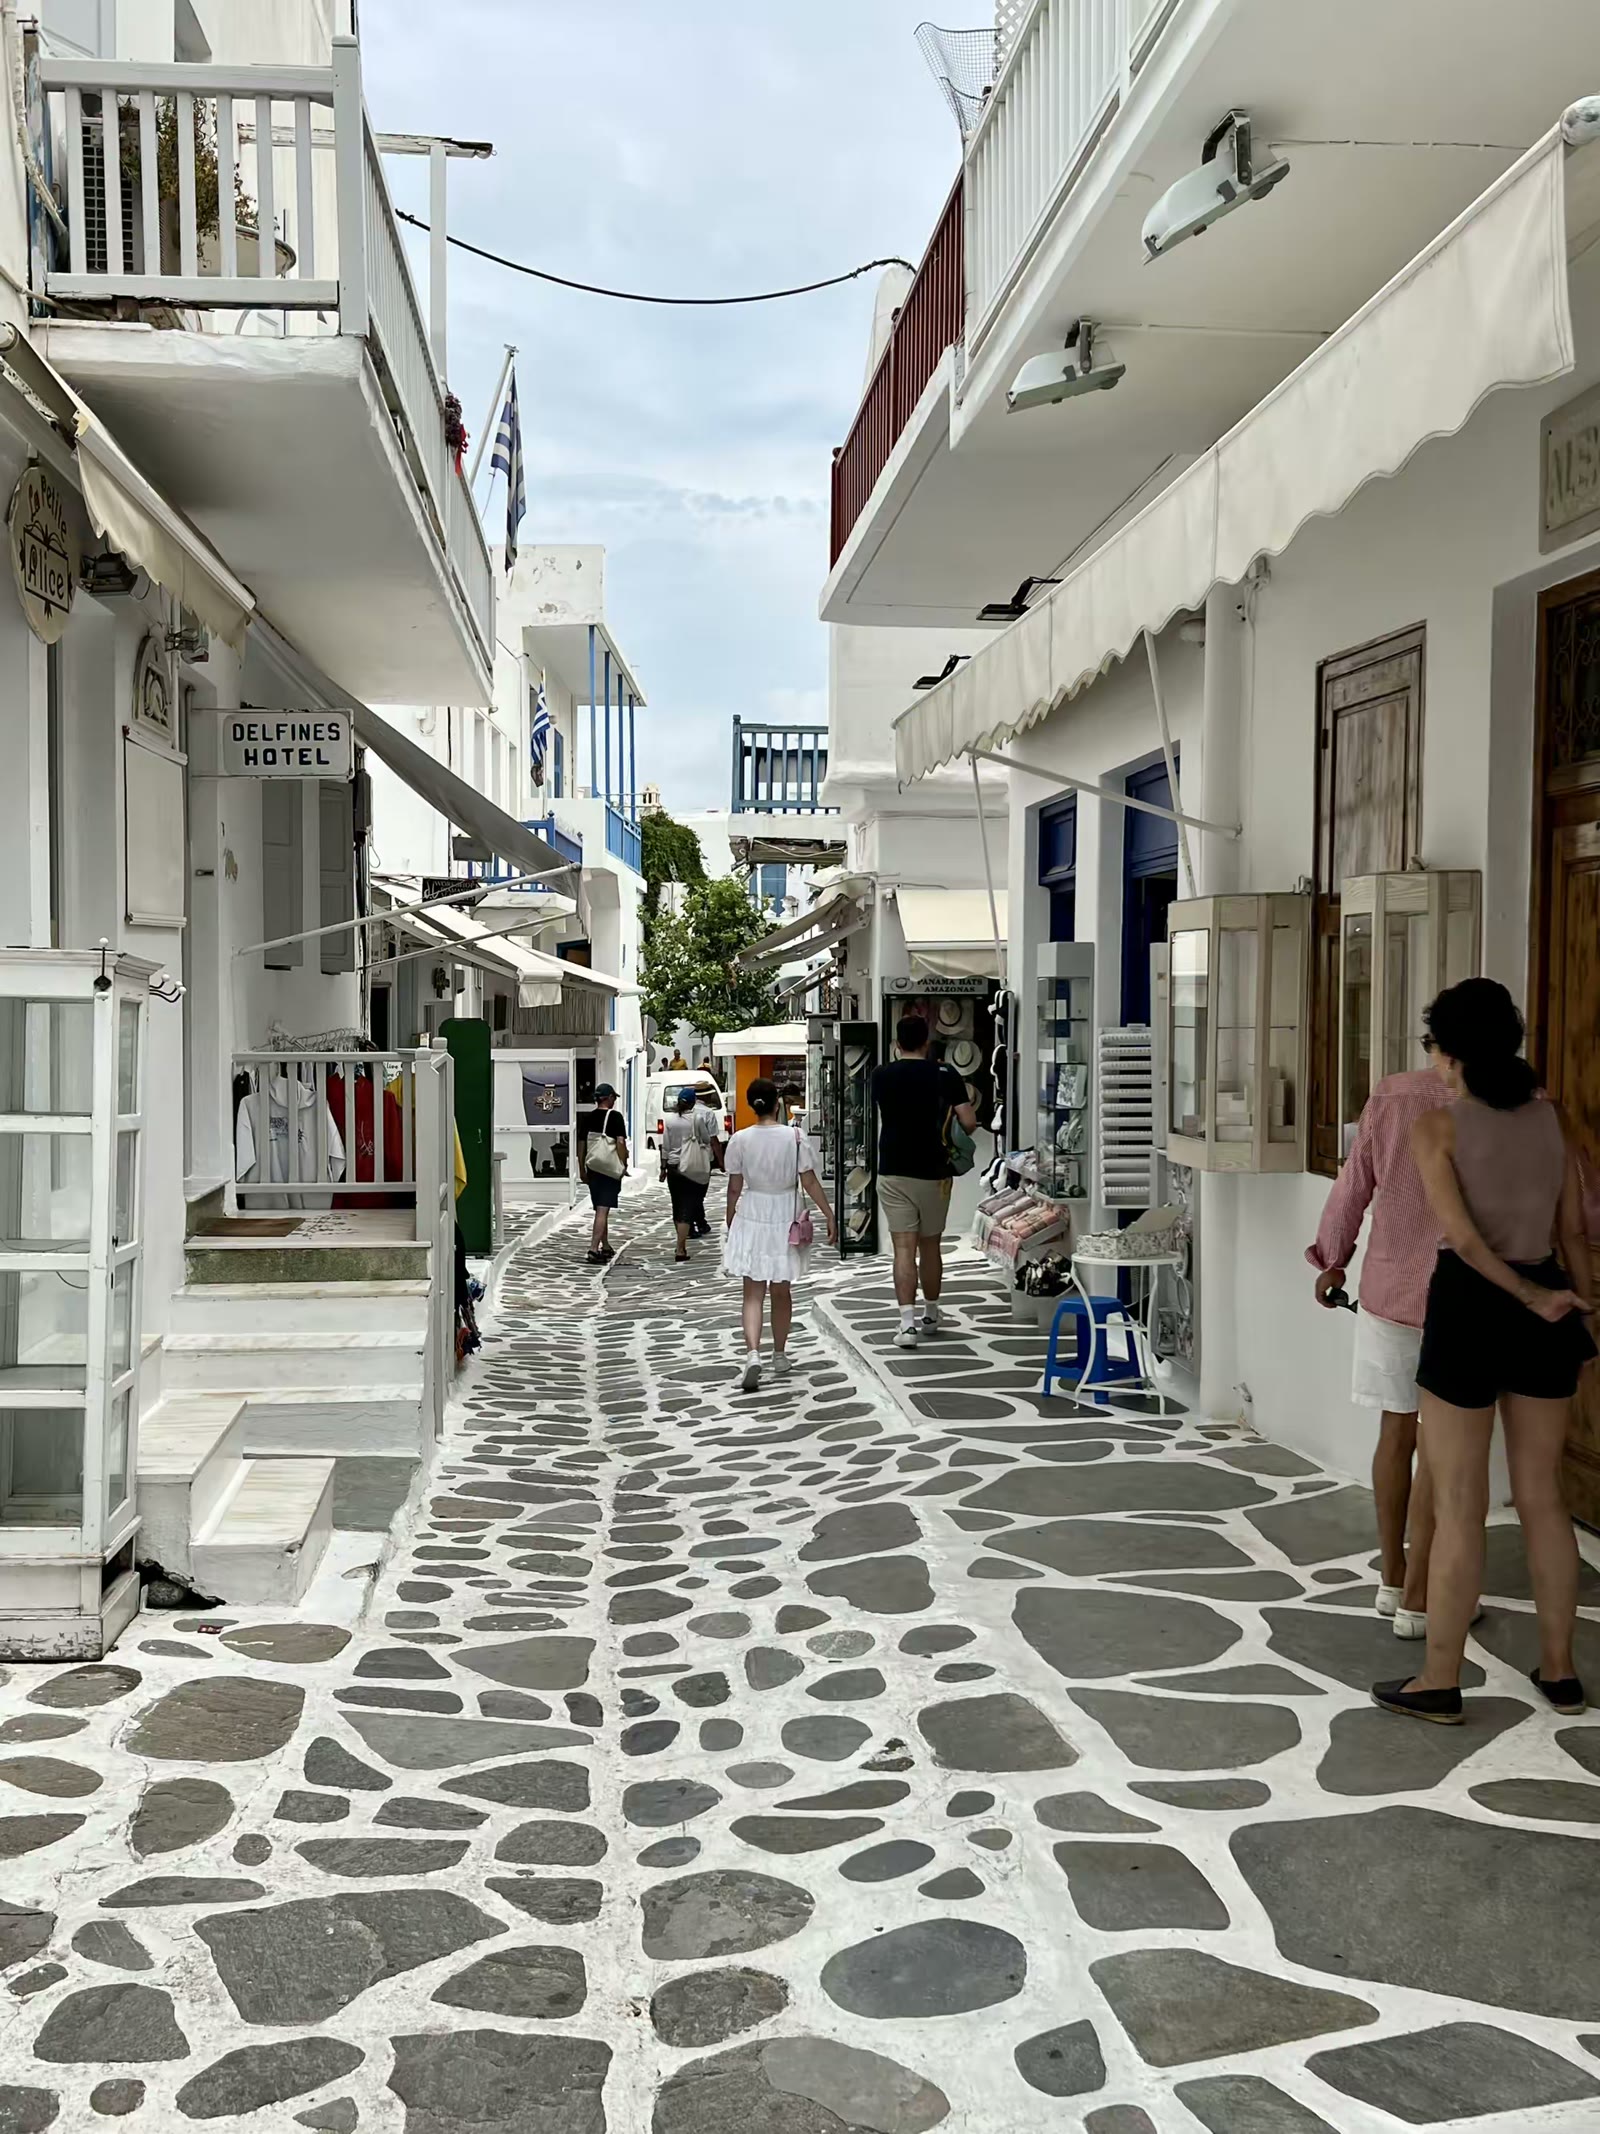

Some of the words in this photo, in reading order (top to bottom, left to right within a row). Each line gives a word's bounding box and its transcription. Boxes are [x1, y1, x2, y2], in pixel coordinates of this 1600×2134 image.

[28, 484, 41, 522] La
[41, 475, 67, 543] Petite
[28, 548, 65, 600] Alice
[232, 722, 340, 742] DELFINES
[244, 747, 330, 766] HOTEL
[917, 978, 956, 986] PANAMA
[958, 978, 983, 986] HATS
[924, 985, 976, 993] AMAZONAS
